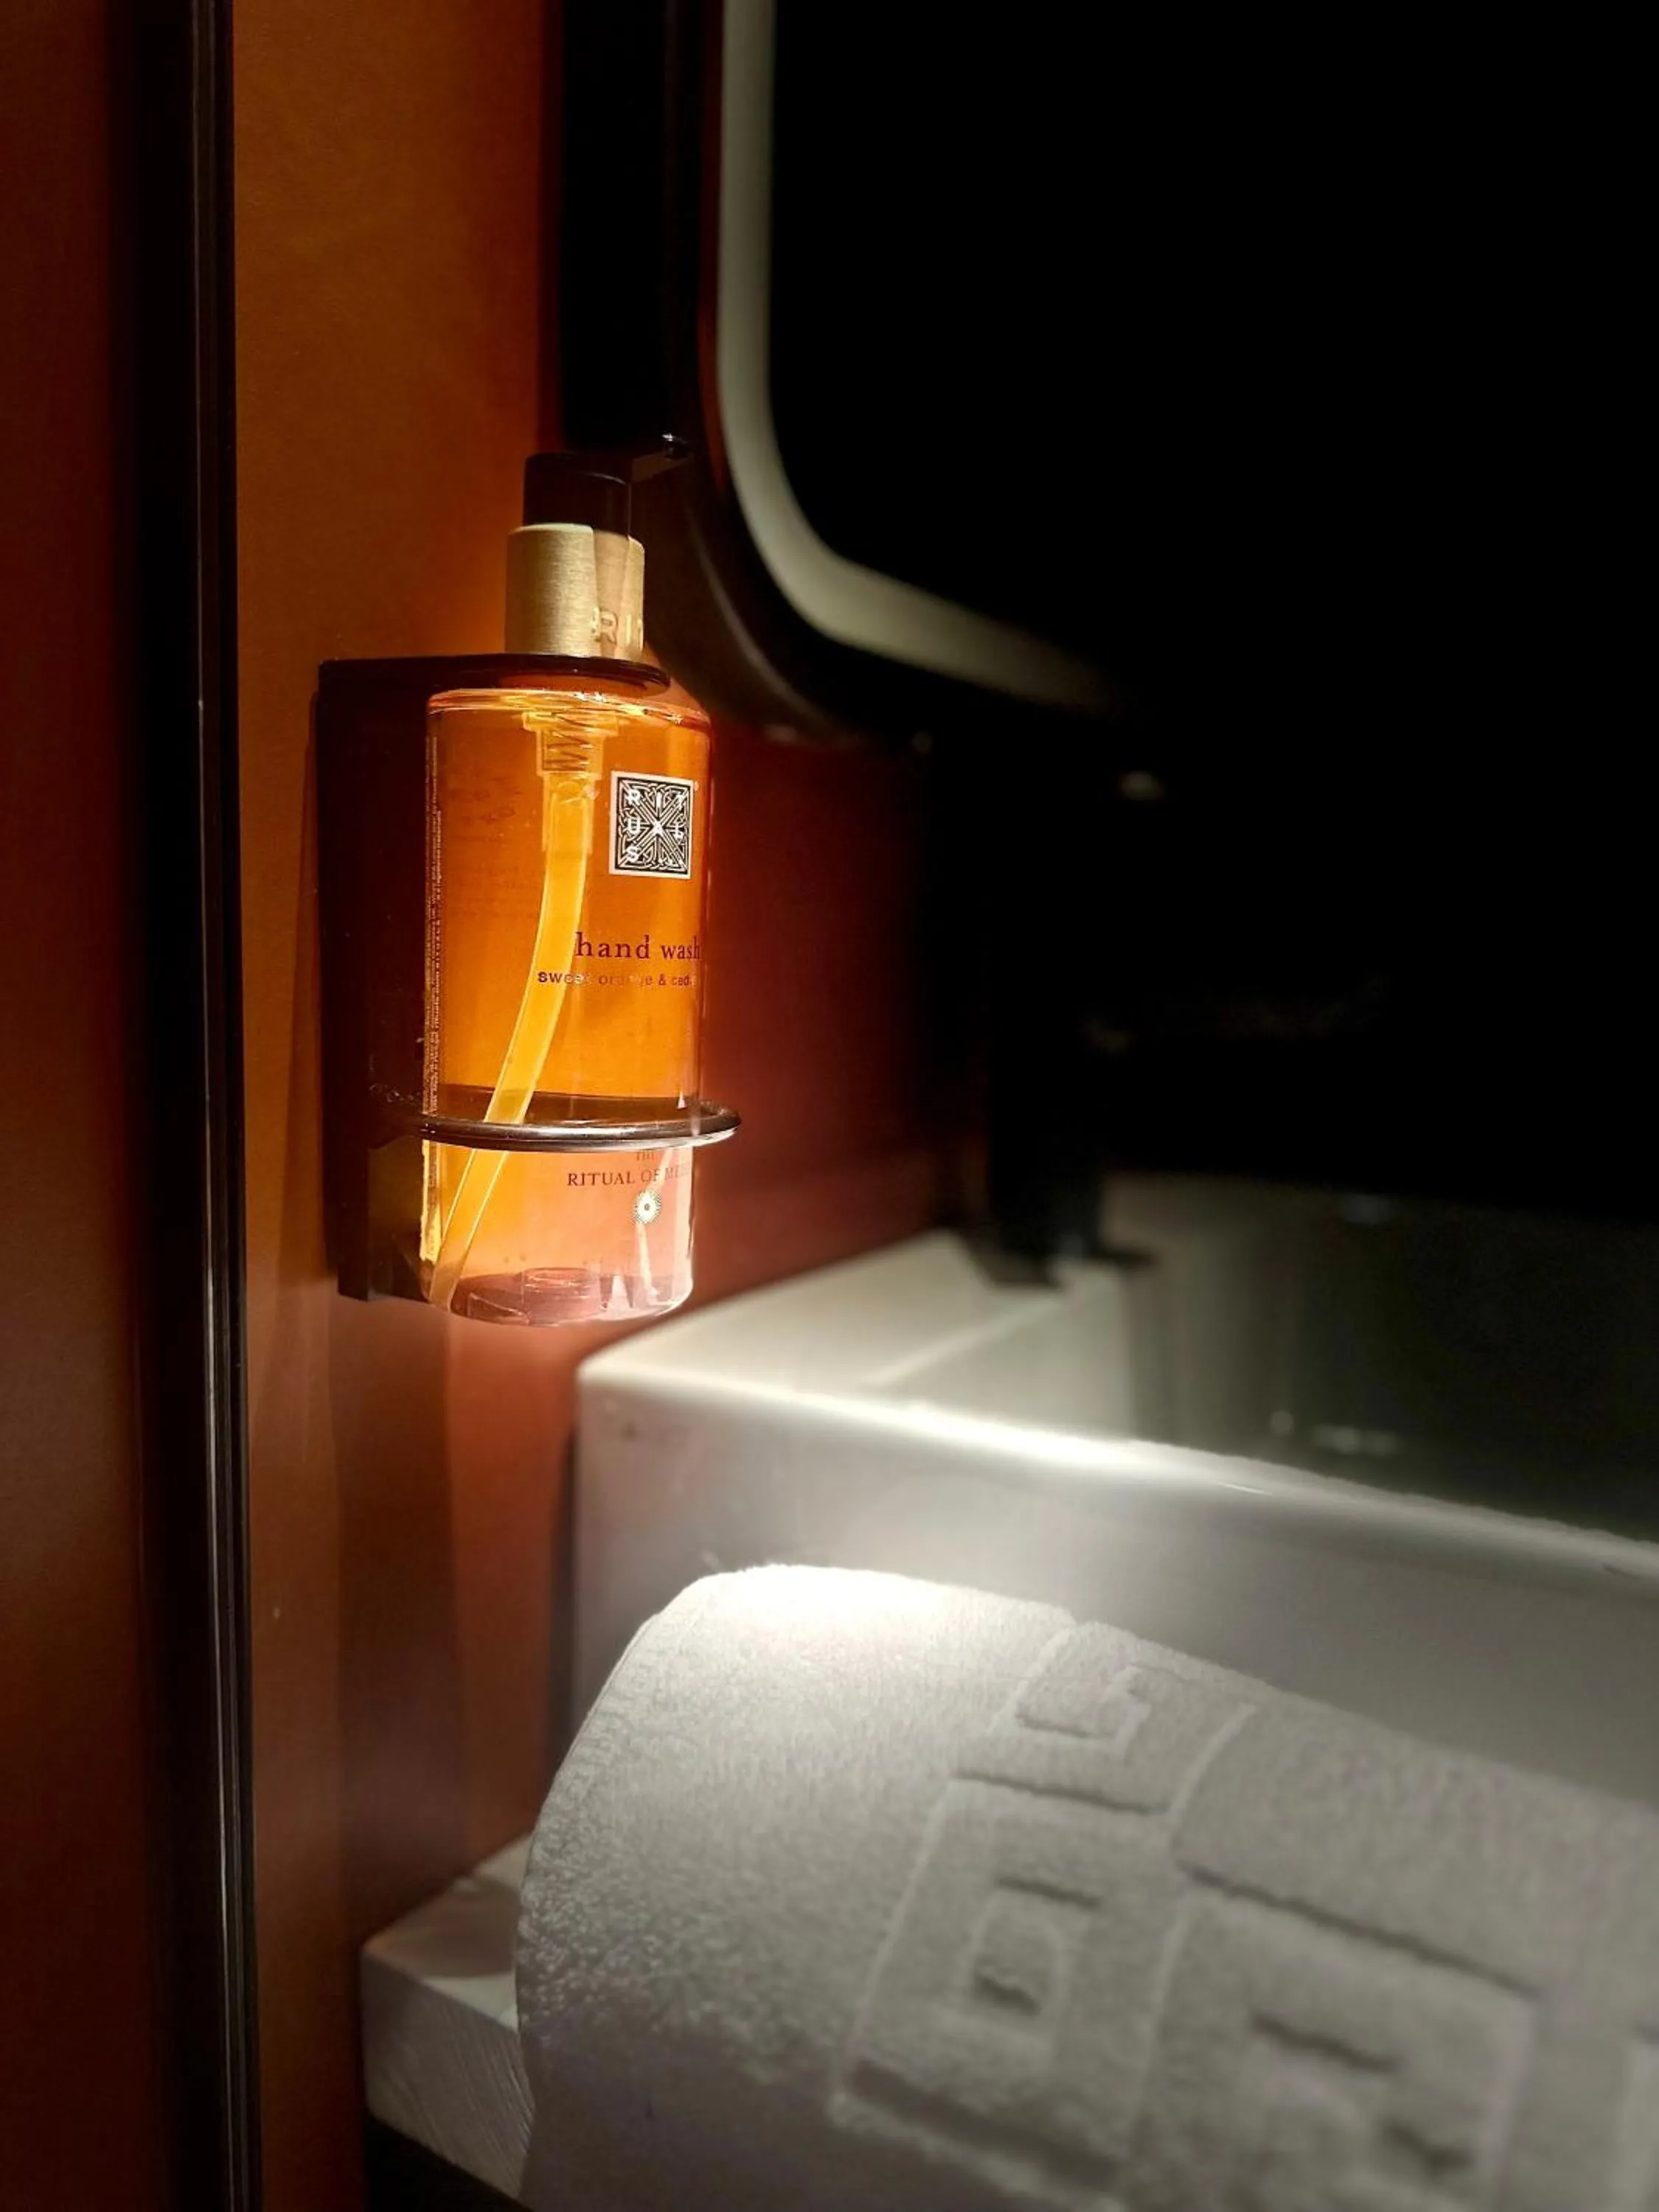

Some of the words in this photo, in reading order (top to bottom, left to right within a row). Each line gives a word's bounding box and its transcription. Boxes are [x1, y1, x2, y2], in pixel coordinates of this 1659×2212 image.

[575, 931, 650, 959] hand
[660, 934, 700, 960] wash
[566, 1169, 636, 1187] RITUAL
[641, 1168, 661, 1183] OF
